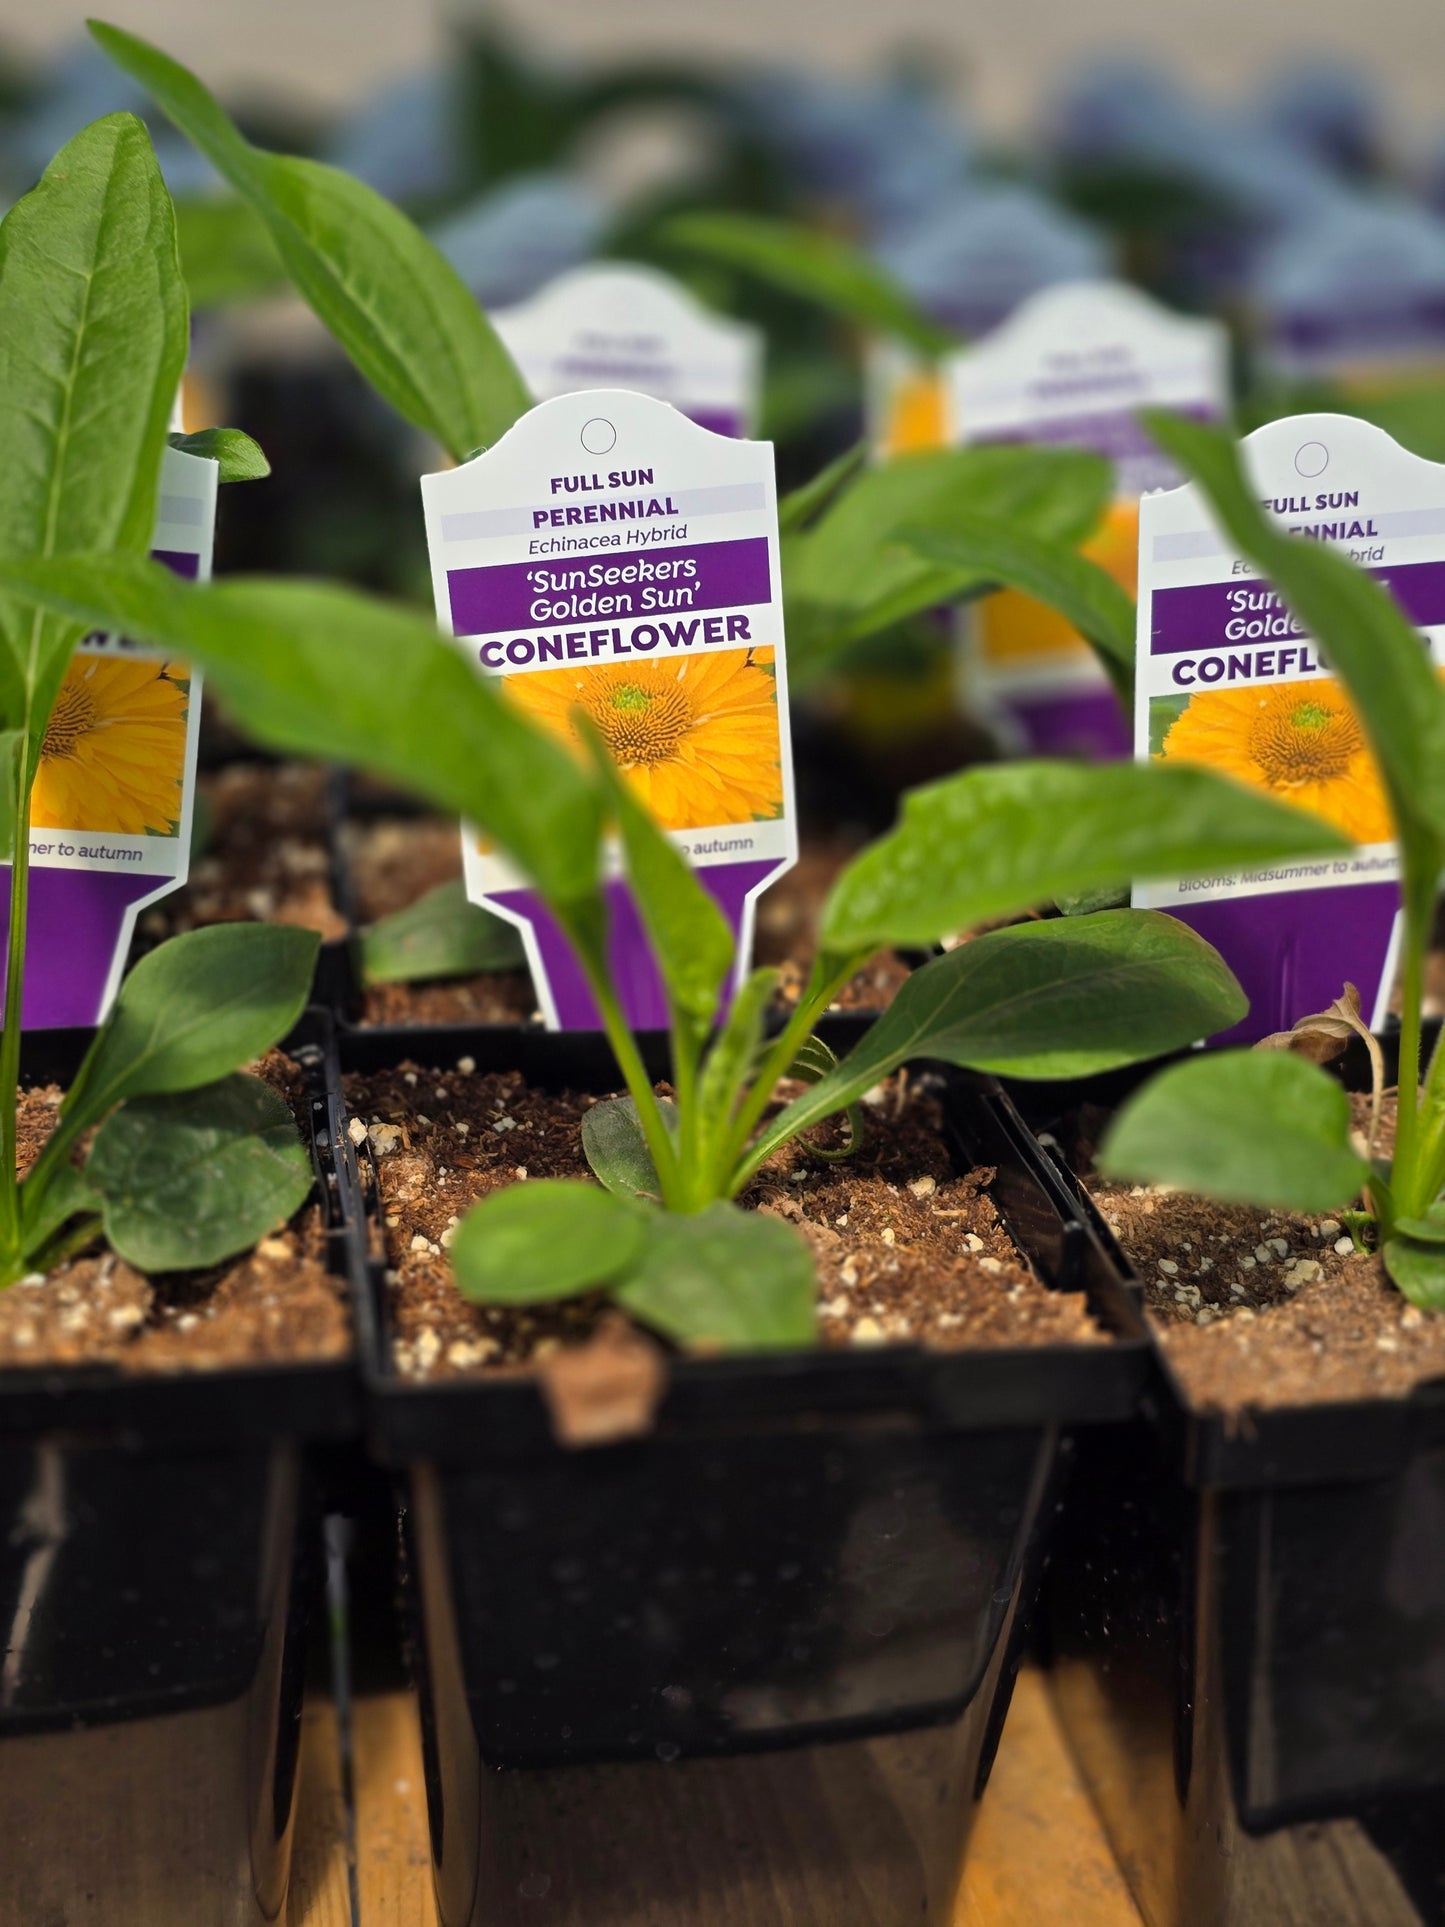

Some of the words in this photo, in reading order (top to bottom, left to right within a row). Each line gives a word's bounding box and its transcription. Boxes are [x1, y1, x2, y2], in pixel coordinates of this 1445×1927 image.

[550, 474, 604, 495] FULL
[608, 468, 654, 488] SUN
[532, 497, 679, 529] PERENNIAL
[1315, 491, 1359, 510] SUN
[528, 534, 621, 555] Echinacea
[626, 524, 688, 546] Hybrid
[1289, 520, 1378, 542] NNIAL
[1347, 546, 1385, 562] brid
[529, 592, 633, 622] Golden
[479, 614, 752, 668] CONEFLOWER
[1225, 614, 1306, 641] Golde
[1171, 646, 1331, 686] CONEFL
[58, 842, 75, 856] to
[78, 845, 143, 862] autumn
[693, 838, 754, 855] autumn
[1332, 861, 1348, 874] to
